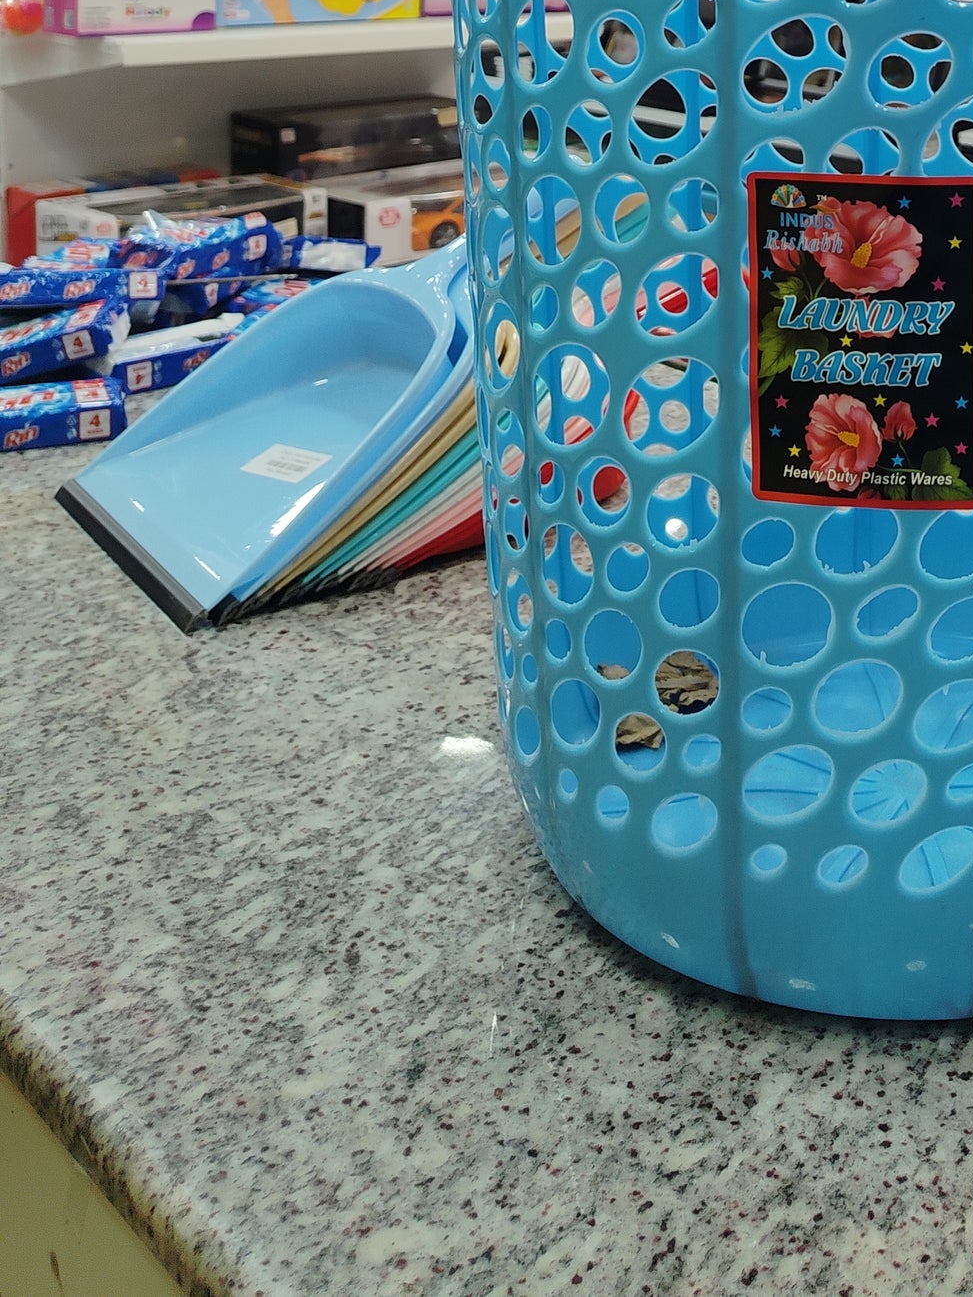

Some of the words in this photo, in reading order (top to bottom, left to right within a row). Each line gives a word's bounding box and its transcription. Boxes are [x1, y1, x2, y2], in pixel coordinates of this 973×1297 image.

[780, 212, 833, 229] INDUS
[763, 229, 843, 253] Rishabh
[778, 295, 955, 335] LAUNDRY
[791, 349, 942, 387] BASKET
[4, 426, 39, 449] Rin
[783, 464, 823, 483] Heavy
[827, 469, 857, 486] Duty
[861, 472, 906, 485] Plastic
[911, 473, 953, 486] Wares
